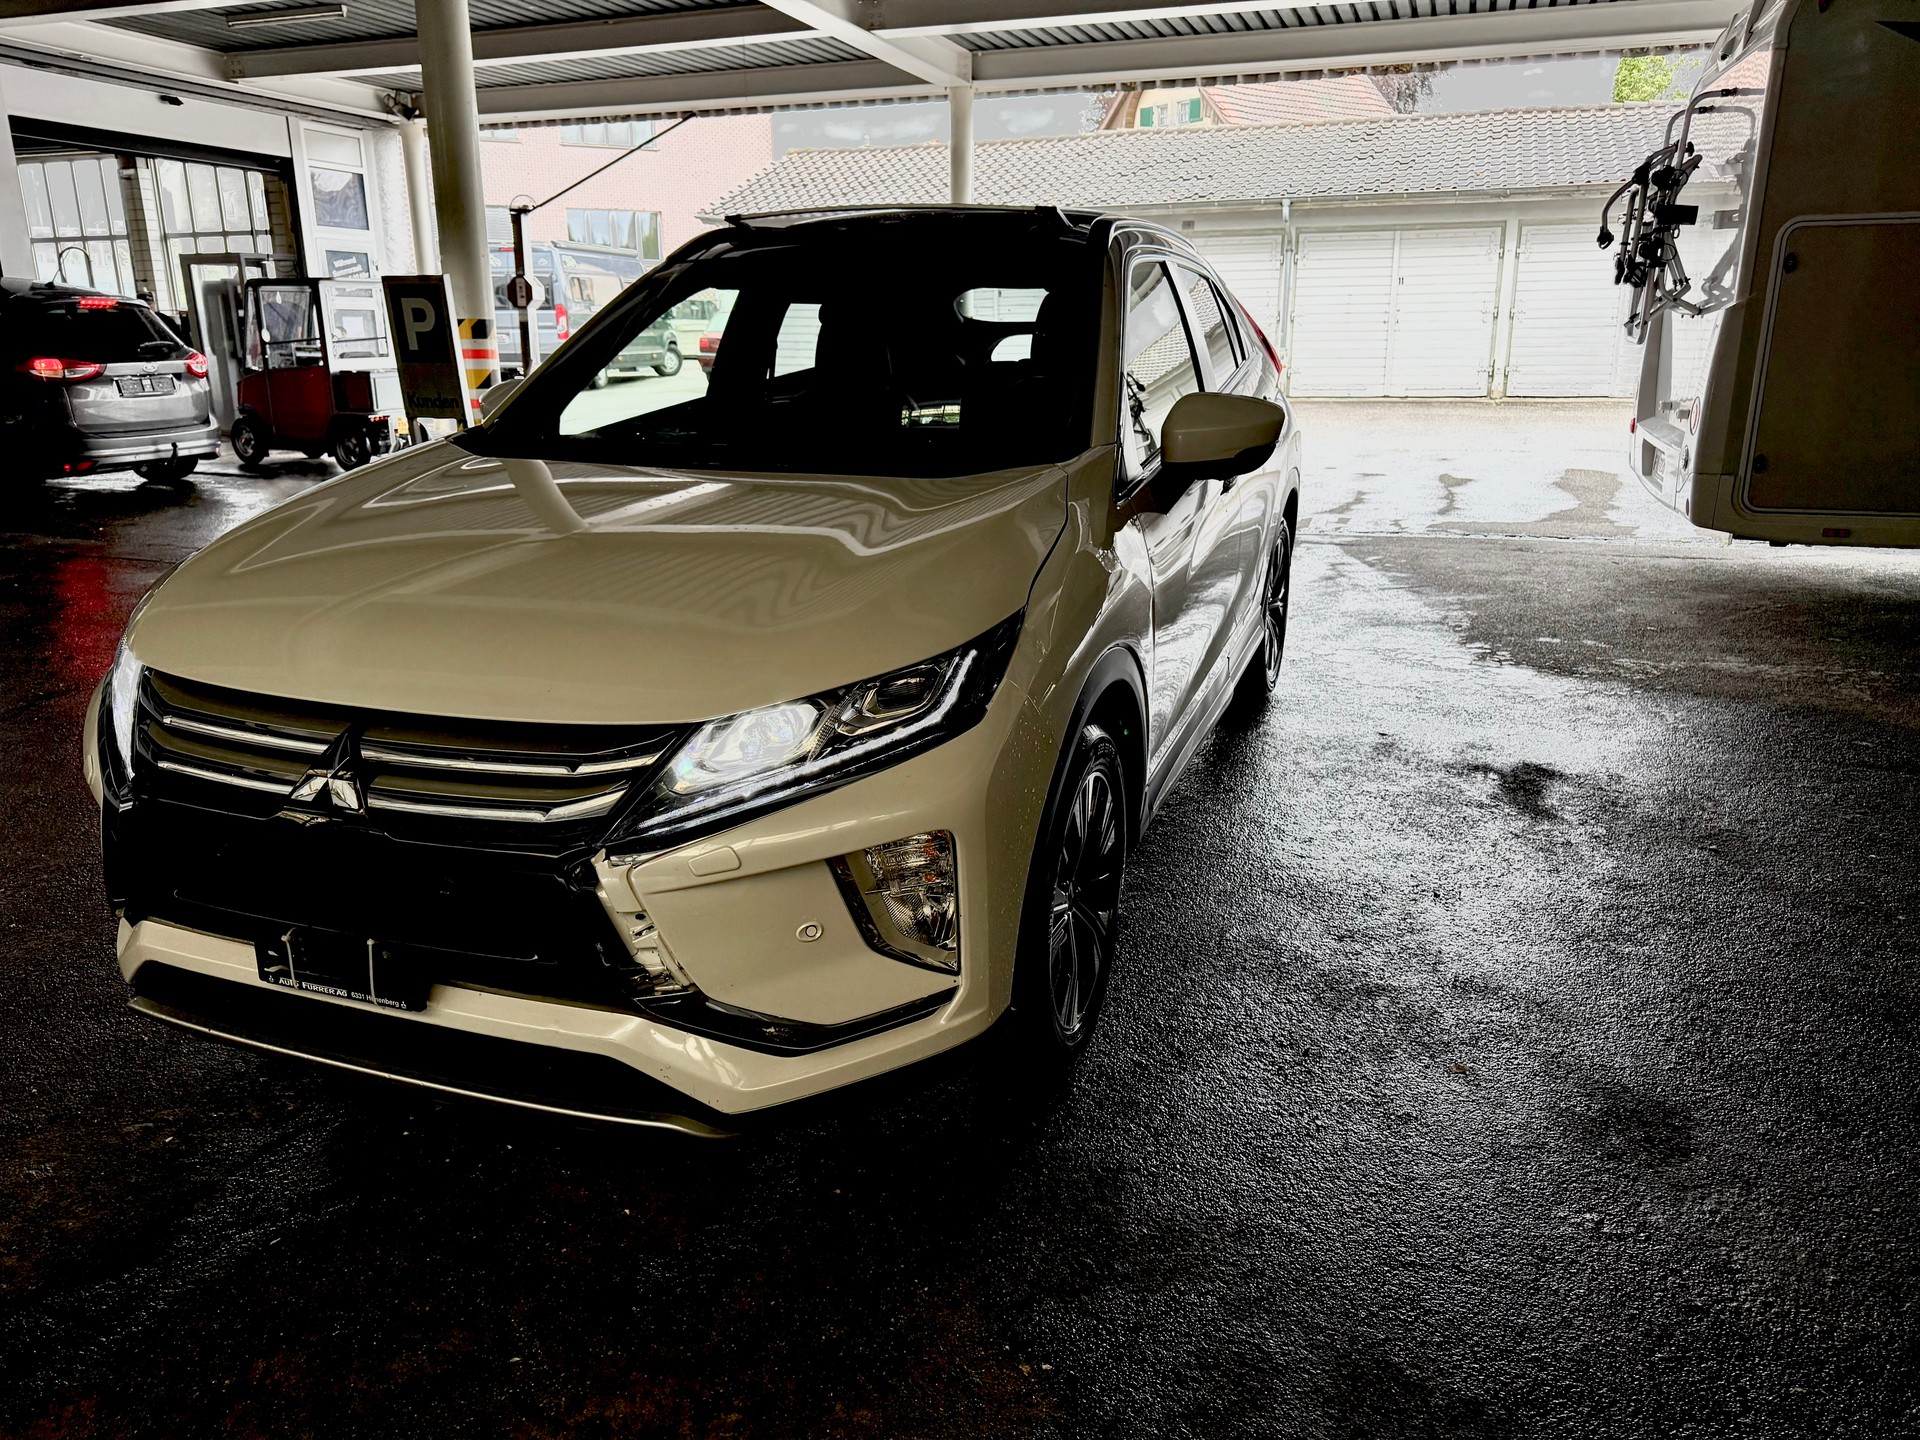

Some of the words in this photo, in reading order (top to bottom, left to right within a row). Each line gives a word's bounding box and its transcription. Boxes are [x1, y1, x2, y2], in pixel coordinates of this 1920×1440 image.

[401, 298, 436, 350] P
[406, 391, 460, 409] Kunden
[302, 981, 335, 995] FURRER
[351, 991, 365, 1000] 6331
[366, 994, 400, 1008] Hnenberg
